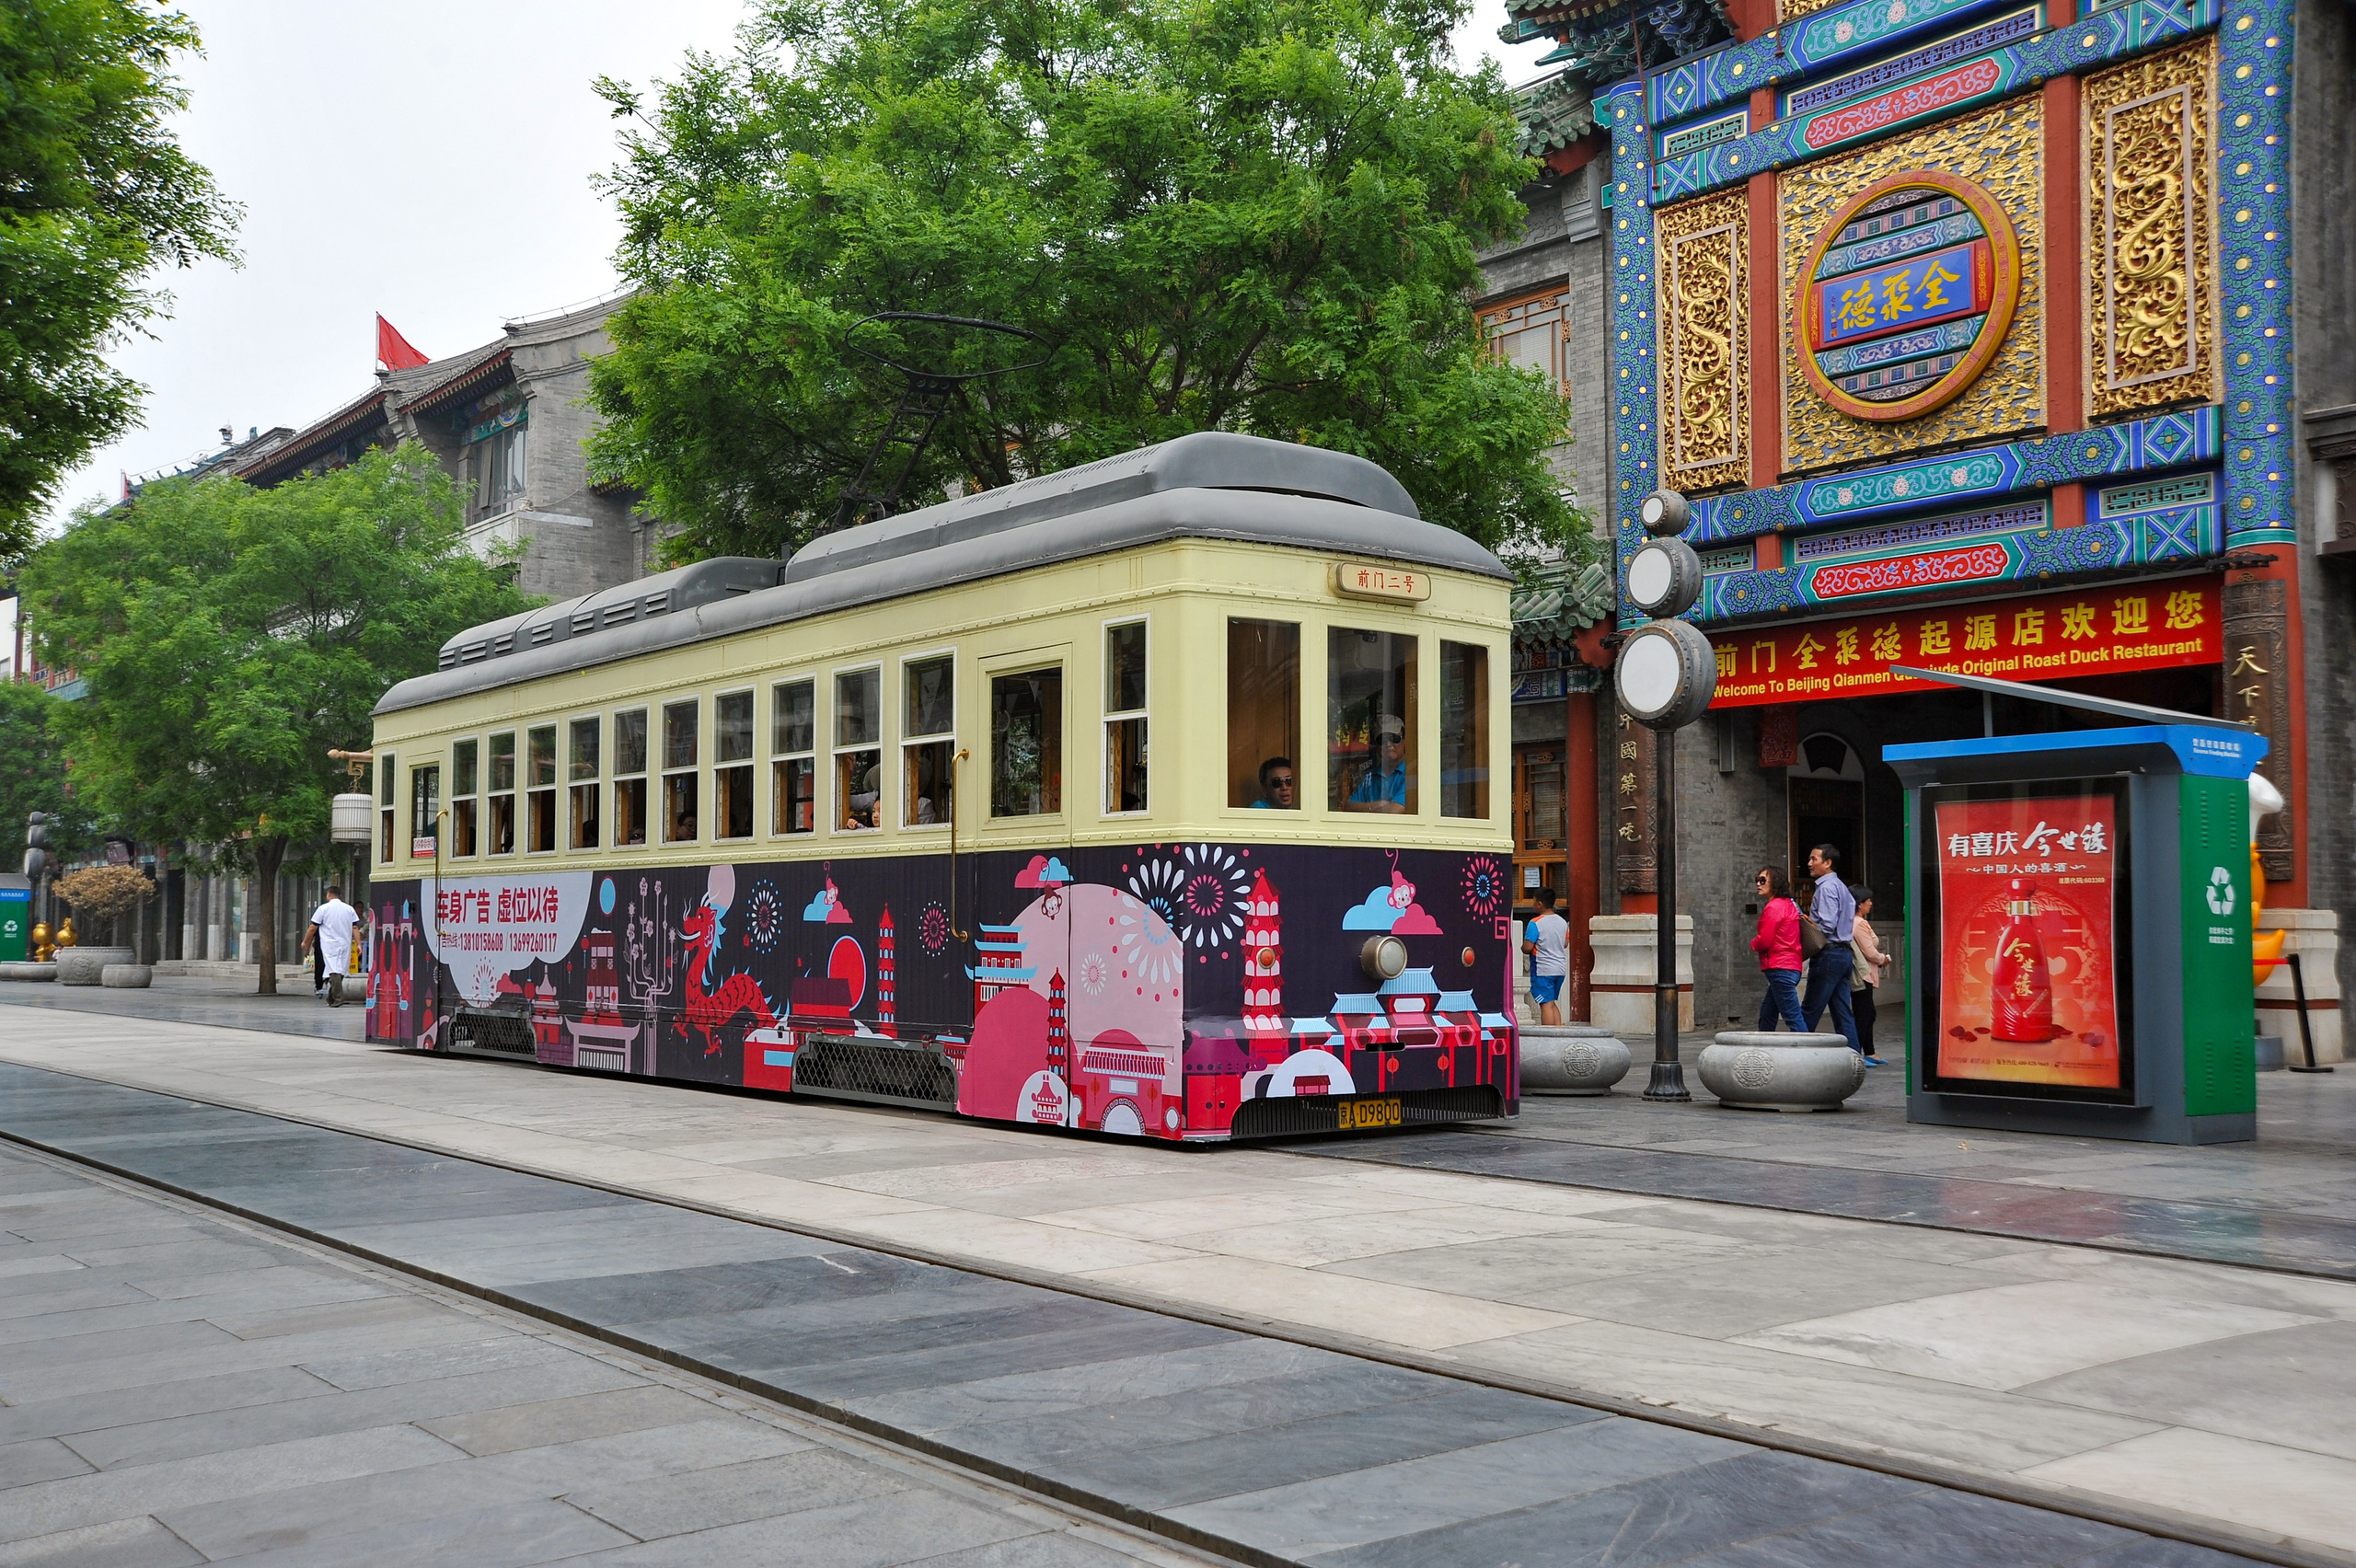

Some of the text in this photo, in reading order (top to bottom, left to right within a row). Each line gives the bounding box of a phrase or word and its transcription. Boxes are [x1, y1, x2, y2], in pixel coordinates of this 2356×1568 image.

[1357, 569, 1415, 594] 前门二号
[1714, 684, 1766, 698] Welcome
[1769, 680, 1783, 693] To
[1787, 675, 1830, 692] Beijing
[1833, 671, 1890, 688] Qianmen
[1962, 656, 2019, 675] Original
[2023, 651, 2066, 669] Roast
[2070, 647, 2109, 664] Duck
[2113, 638, 2202, 661] Restaurant
[437, 885, 559, 924] 车身广告 虚位以待
[509, 932, 557, 952] 13699260117
